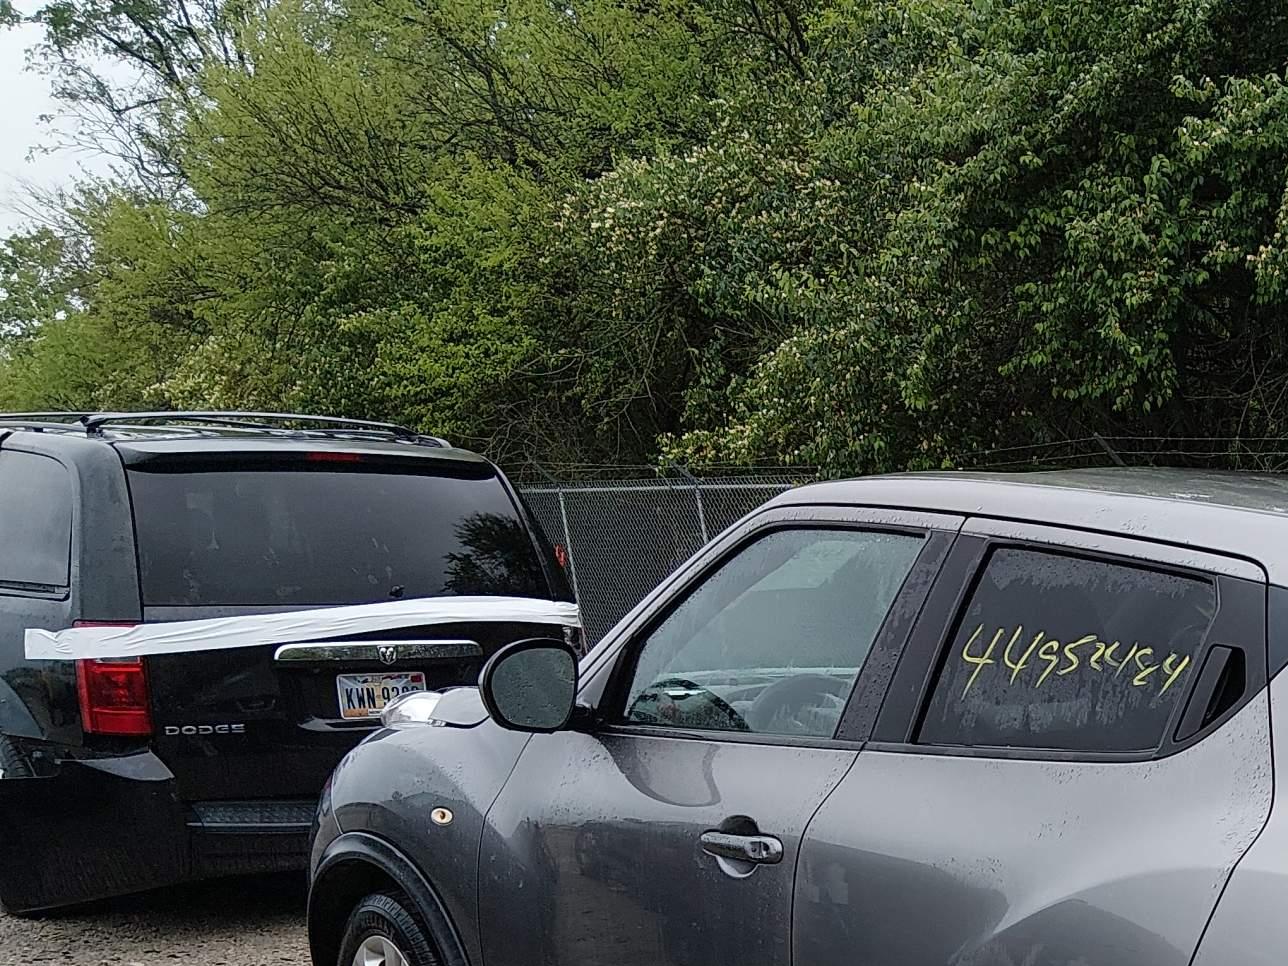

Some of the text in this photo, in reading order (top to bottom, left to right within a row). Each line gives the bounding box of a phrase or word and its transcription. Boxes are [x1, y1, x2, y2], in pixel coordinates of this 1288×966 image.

[961, 623, 1190, 701] 44952484
[345, 687, 377, 709] KWN
[164, 723, 245, 735] DODGE
